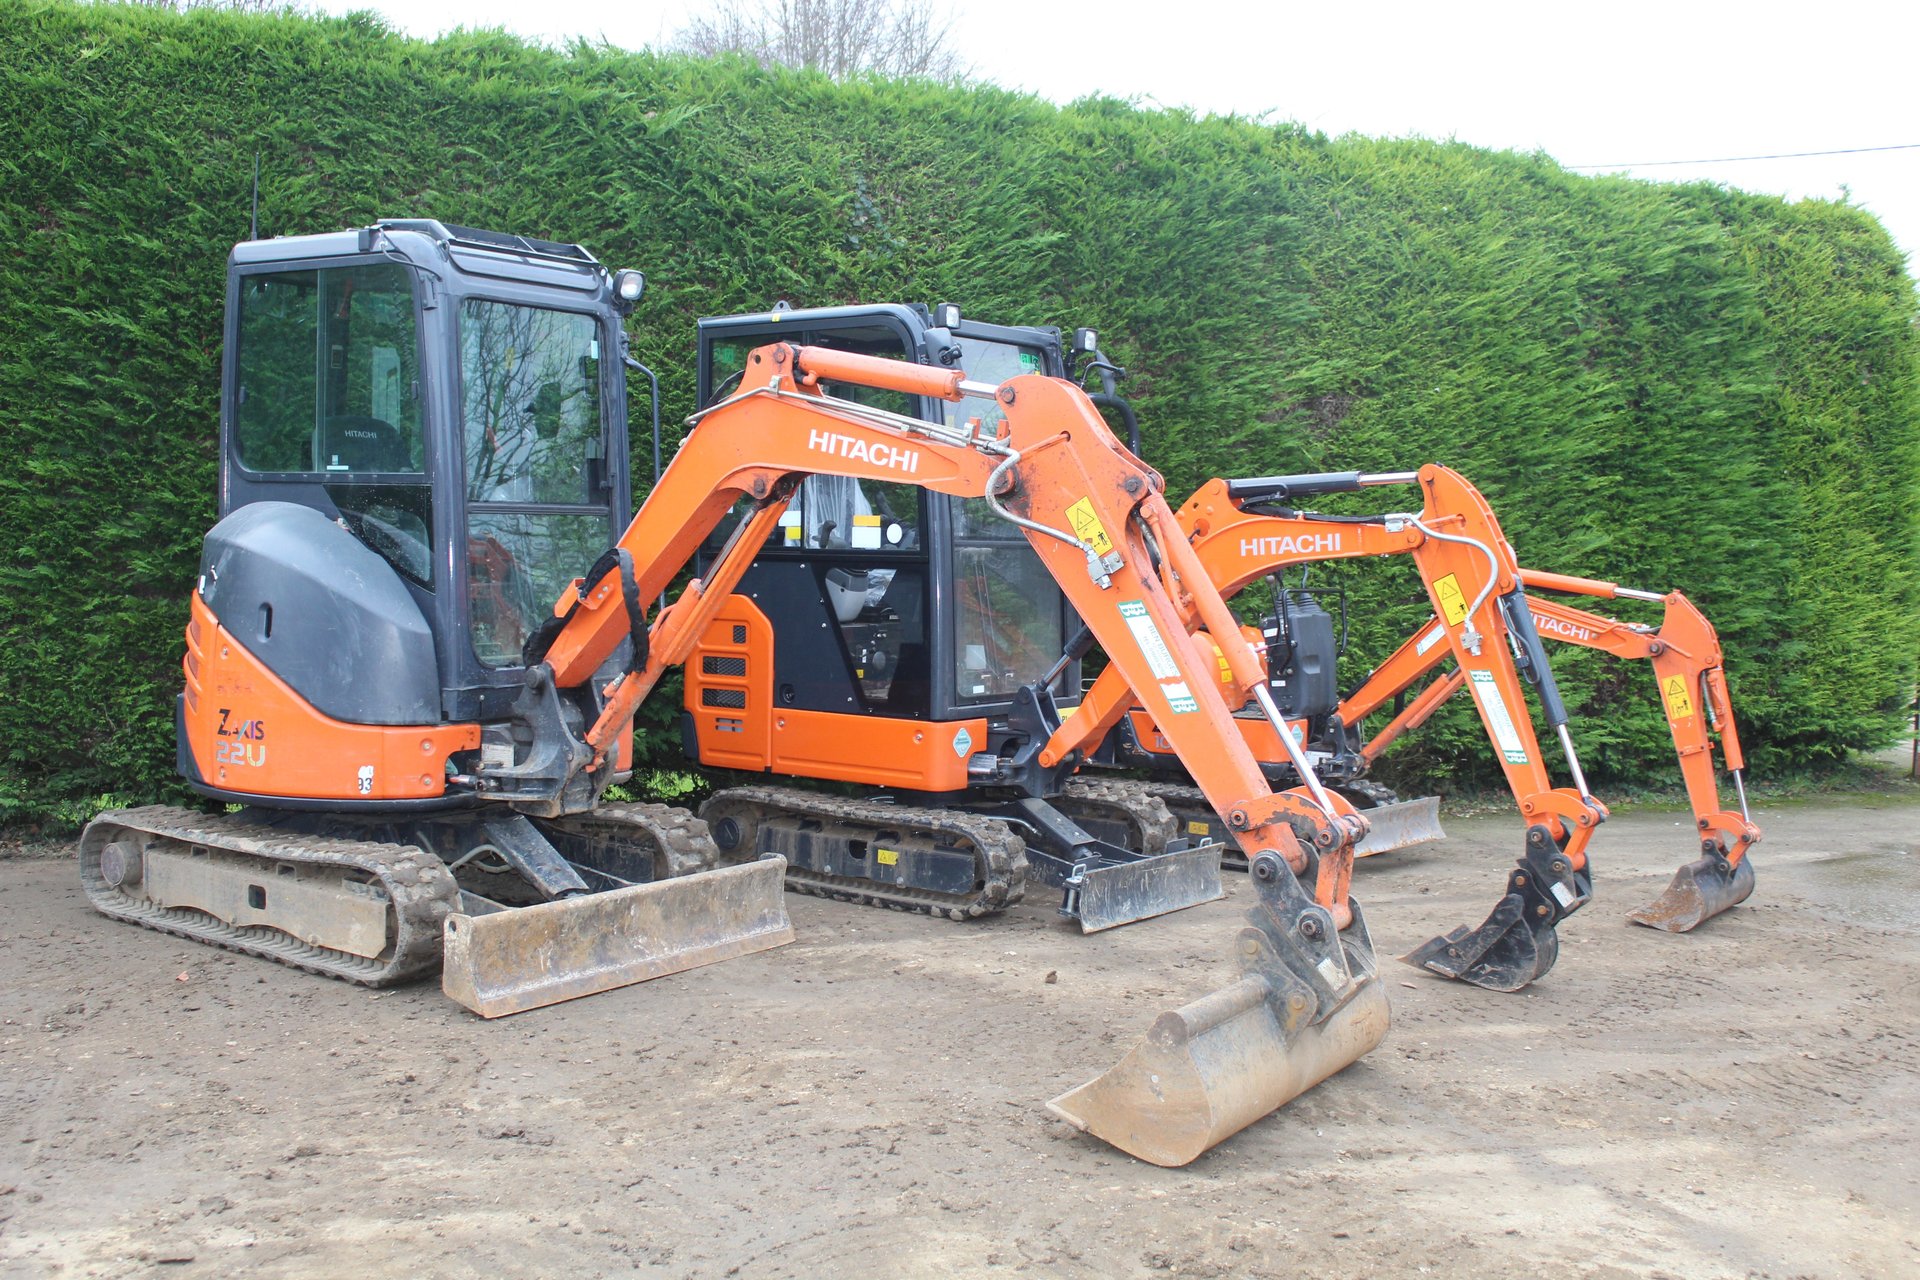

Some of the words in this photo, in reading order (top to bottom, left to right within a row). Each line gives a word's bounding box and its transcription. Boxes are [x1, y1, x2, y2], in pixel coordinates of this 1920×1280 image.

[344, 430, 377, 439] HITACHI
[808, 429, 919, 473] HITACHI
[1240, 533, 1341, 557] HITACHI
[1530, 612, 1590, 641] ITACHI
[216, 740, 266, 767] 22U
